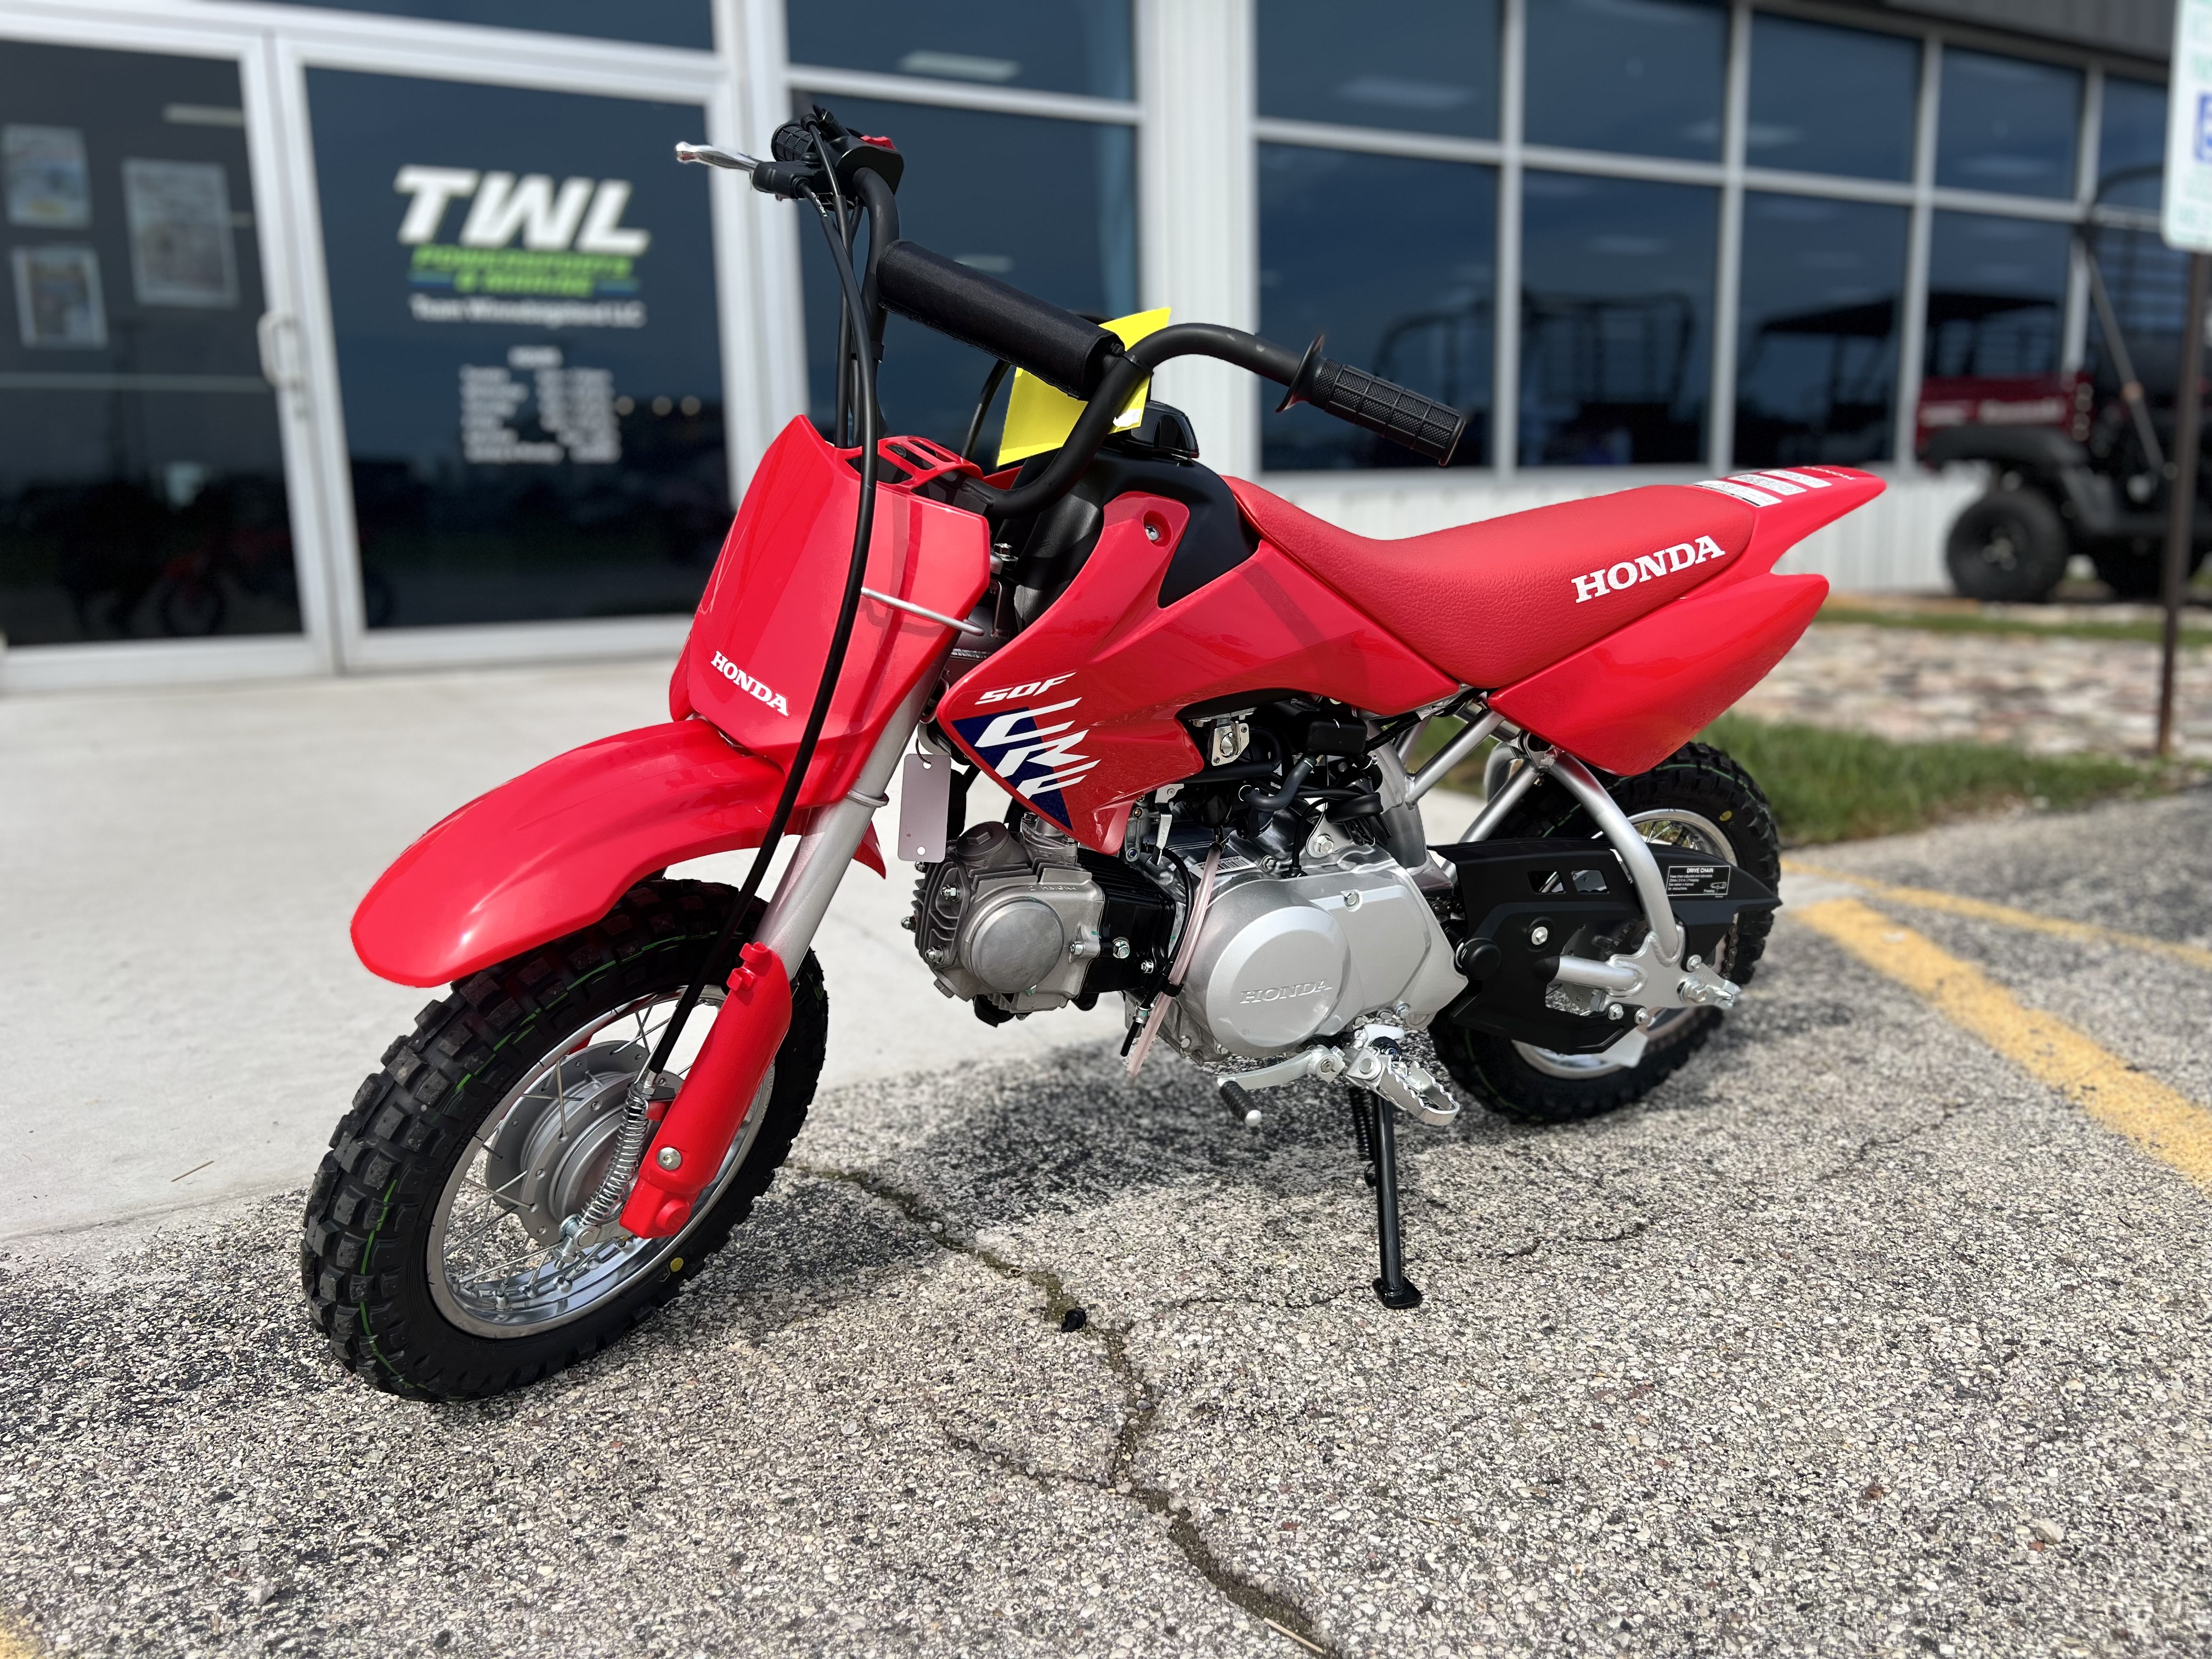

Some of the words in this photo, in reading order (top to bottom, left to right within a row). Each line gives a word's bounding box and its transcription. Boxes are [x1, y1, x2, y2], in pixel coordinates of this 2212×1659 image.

[394, 163, 650, 255] TWL
[1571, 535, 1725, 603] HONDA
[710, 650, 789, 717] HONDA
[975, 672, 1076, 705] 50F
[974, 697, 1102, 799] CRF
[1240, 979, 1333, 1003] HONDA
